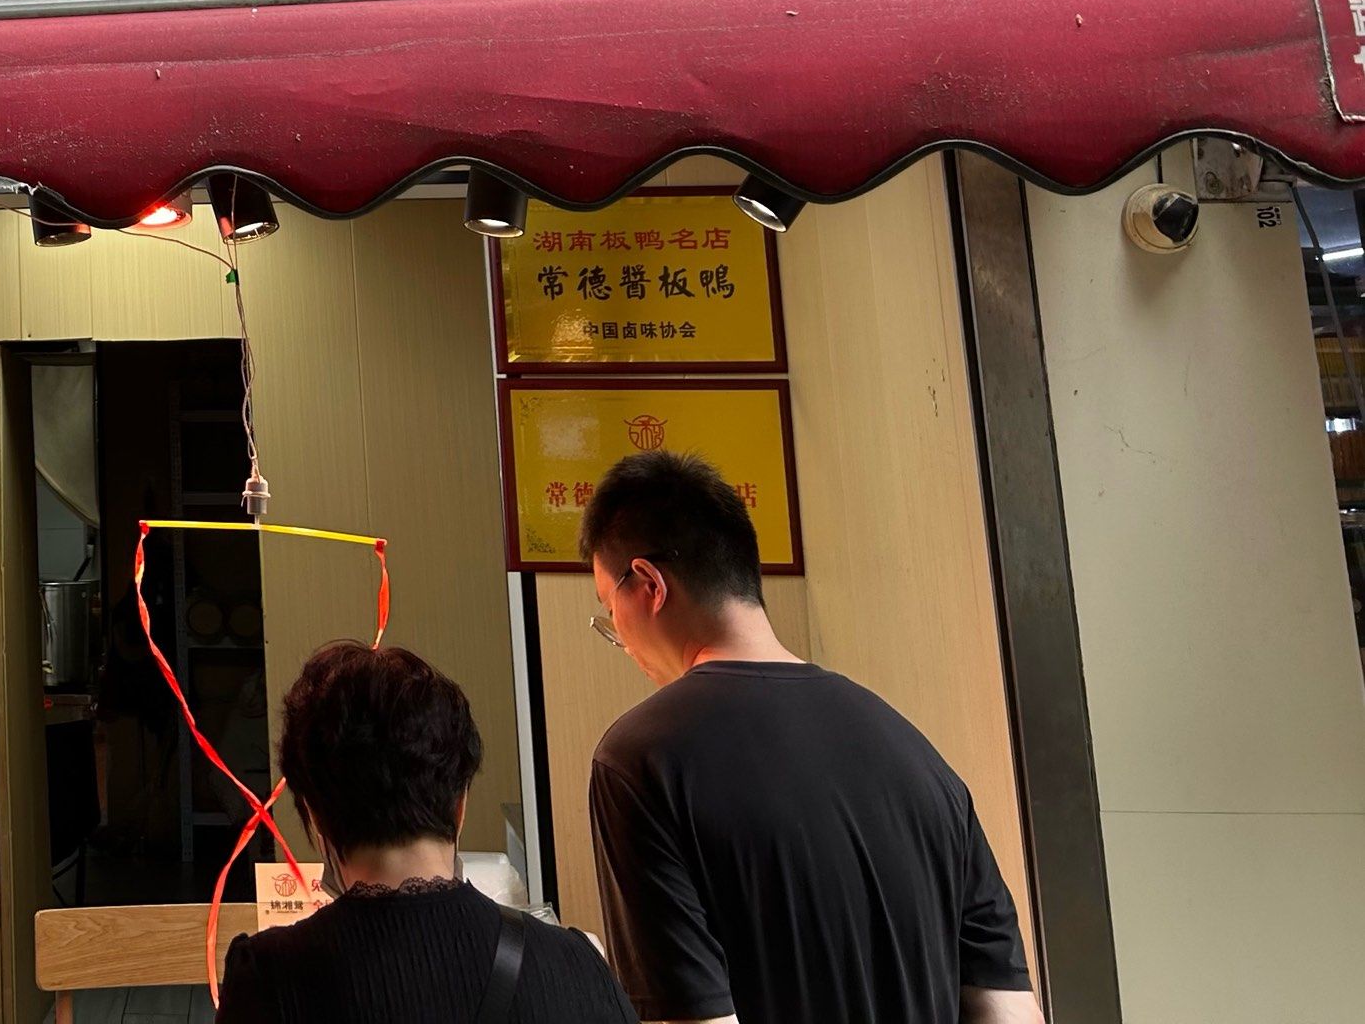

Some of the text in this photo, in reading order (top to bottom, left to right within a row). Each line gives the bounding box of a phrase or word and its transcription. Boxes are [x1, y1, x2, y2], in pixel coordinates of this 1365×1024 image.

[533, 228, 731, 252] 湖南板鸭名店
[585, 321, 697, 339] 中国卤味协会
